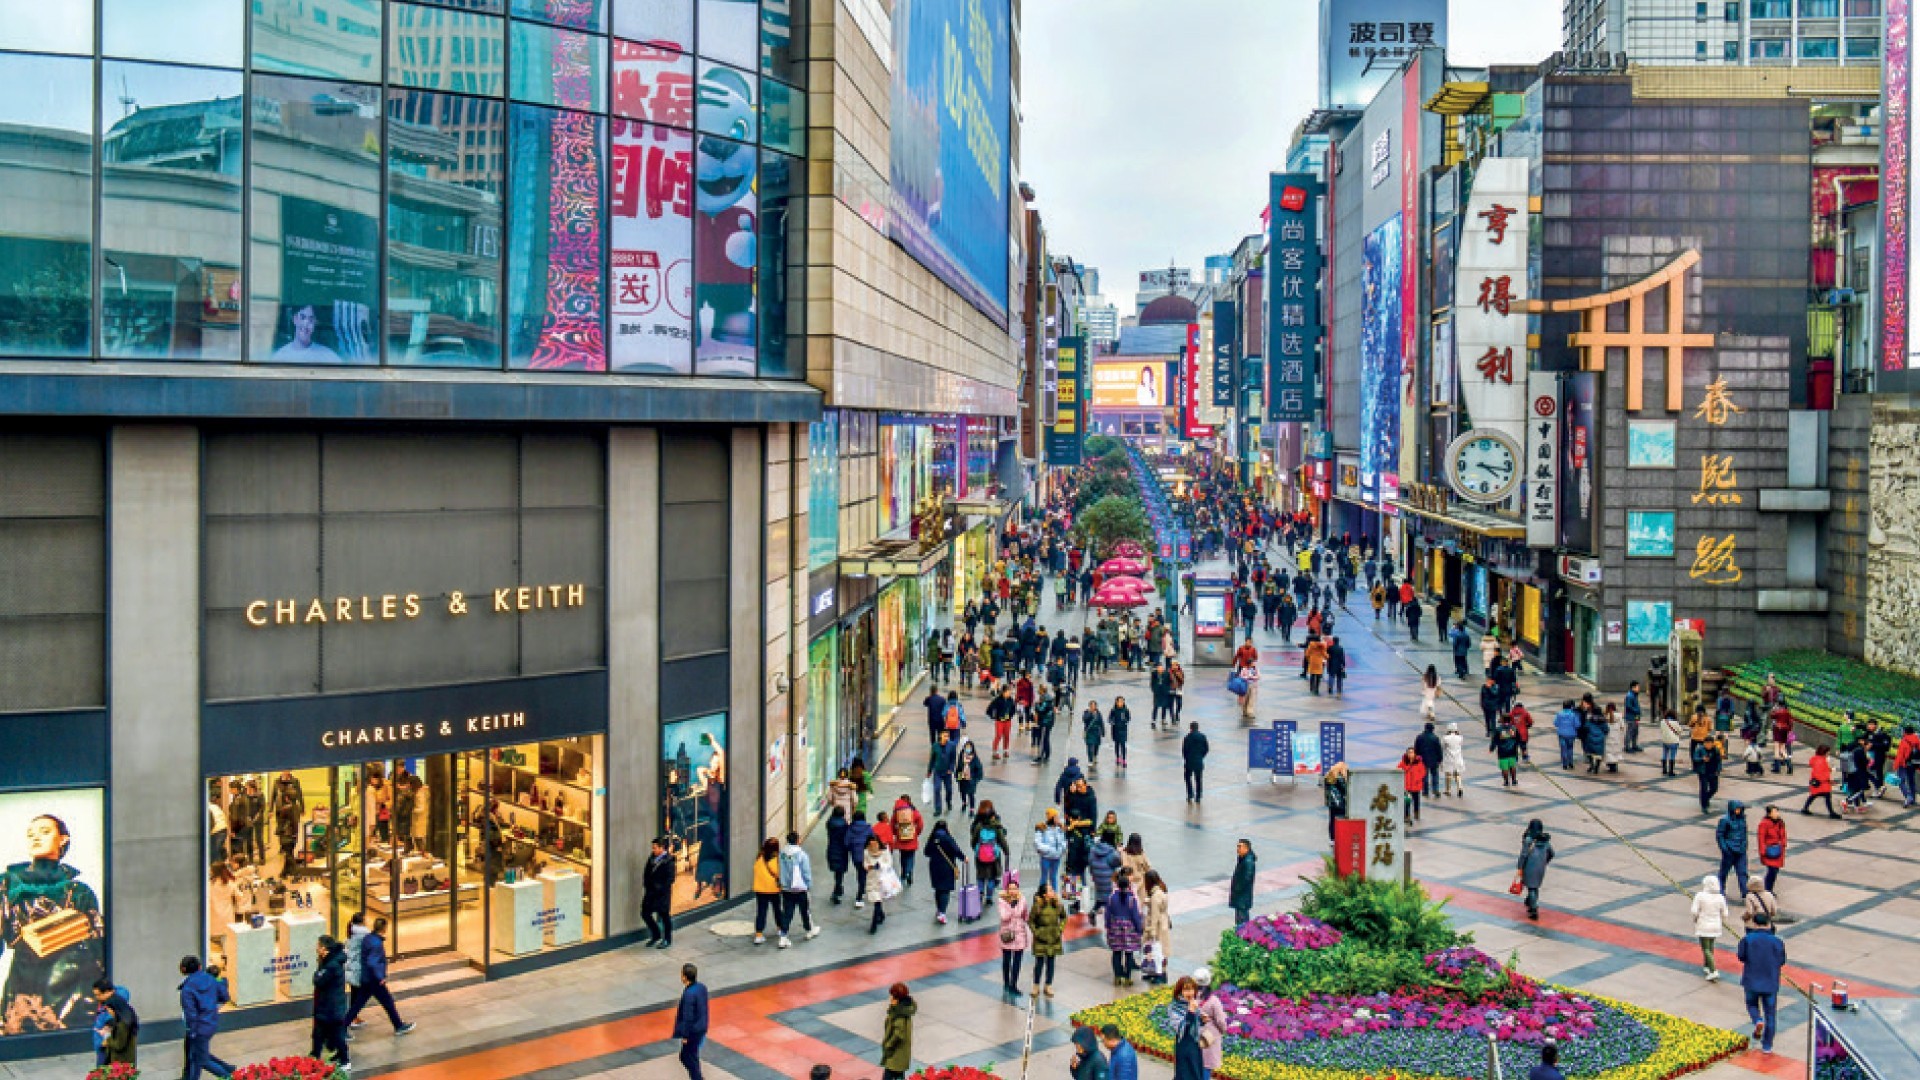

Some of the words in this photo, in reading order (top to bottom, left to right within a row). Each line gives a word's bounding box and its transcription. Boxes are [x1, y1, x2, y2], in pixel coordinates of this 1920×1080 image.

[1349, 22, 1434, 44] 波司登
[1281, 219, 1305, 411] 尚客优精选酒店
[1476, 203, 1518, 386] 亨得利
[1218, 344, 1230, 400] KAMA
[1535, 421, 1553, 500] 中国银行
[1688, 375, 1745, 584] 春熙路
[247, 592, 421, 627] CHARLES
[448, 590, 468, 615] &
[494, 583, 586, 613] KEITH
[321, 721, 425, 748] CHARLES
[440, 719, 453, 736] &
[467, 711, 527, 733] KEITH
[1370, 783, 1398, 866] 春熙路
